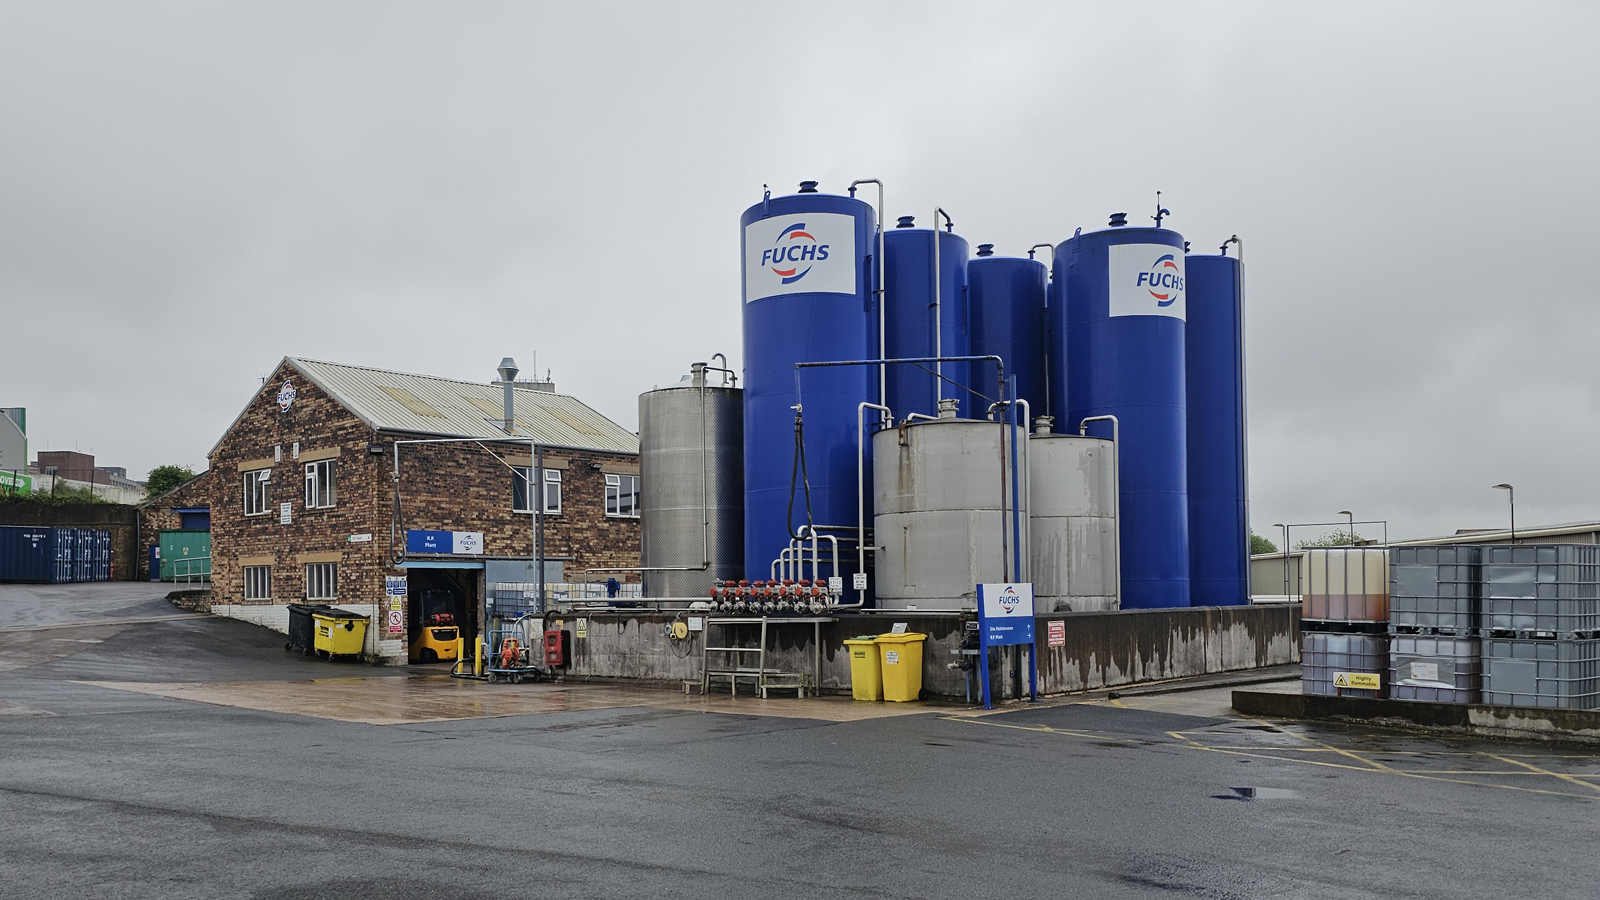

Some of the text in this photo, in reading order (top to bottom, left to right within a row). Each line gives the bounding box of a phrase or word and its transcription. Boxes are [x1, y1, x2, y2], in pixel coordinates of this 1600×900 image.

[761, 244, 830, 267] FUCHS
[1136, 272, 1184, 291] FUCHS
[277, 390, 296, 402] FUCHS
[999, 596, 1020, 604] FUCHS
